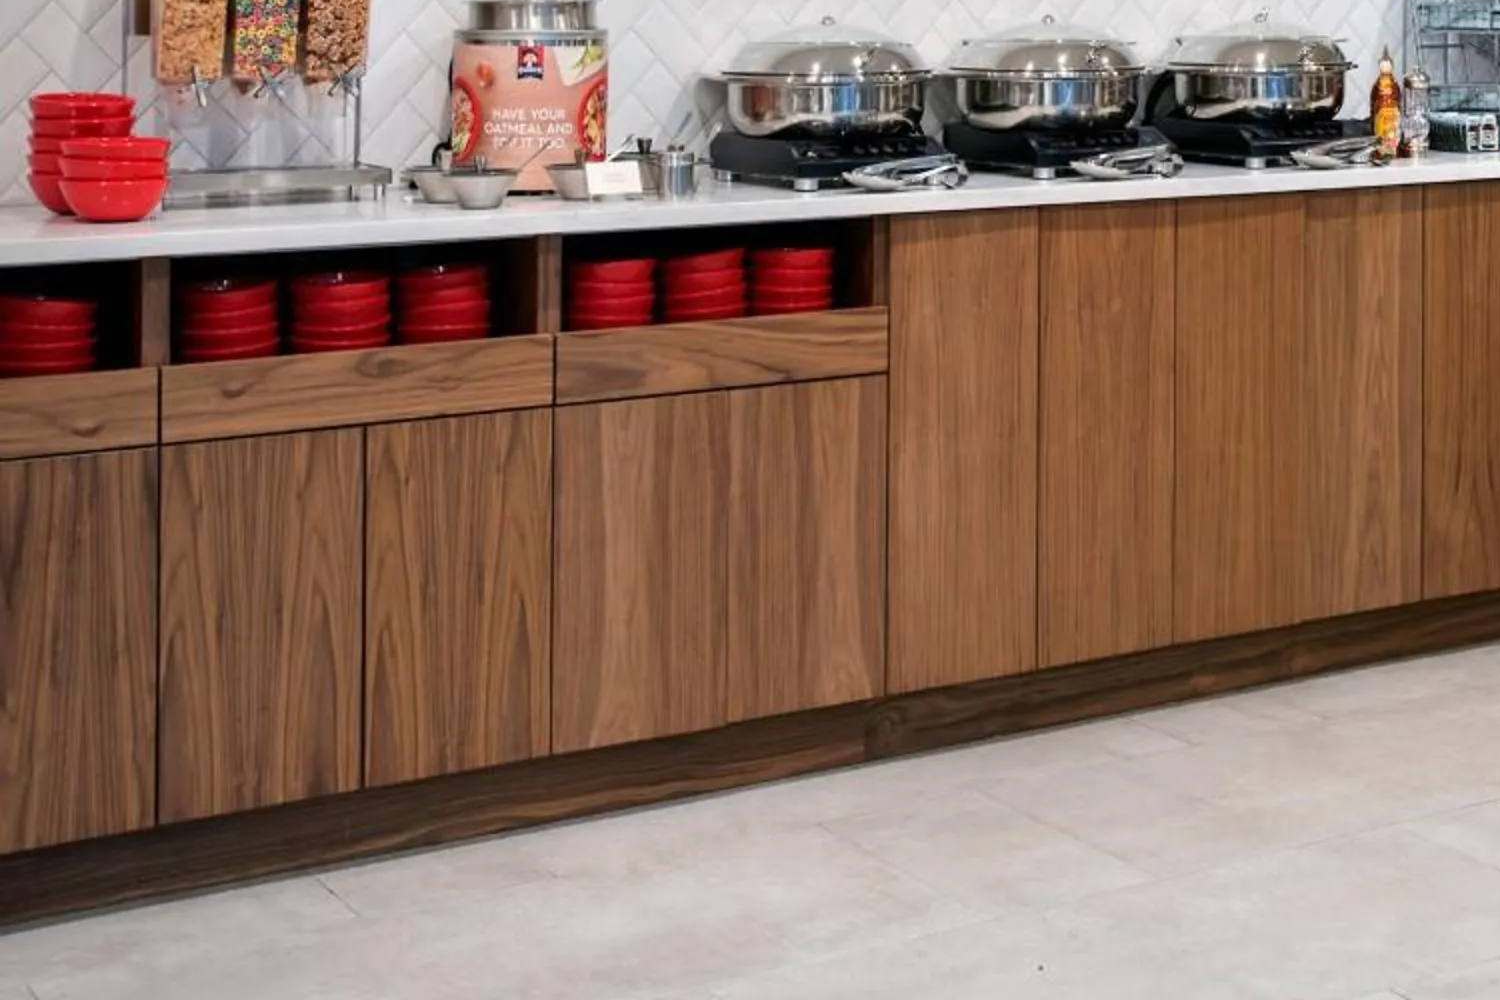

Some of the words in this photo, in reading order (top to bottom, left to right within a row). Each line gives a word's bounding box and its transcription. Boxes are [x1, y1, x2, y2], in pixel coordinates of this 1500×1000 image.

[493, 108, 526, 120] HAVE
[532, 107, 566, 120] YOUR
[483, 121, 543, 135] OATMEAL
[547, 122, 574, 135] AND
